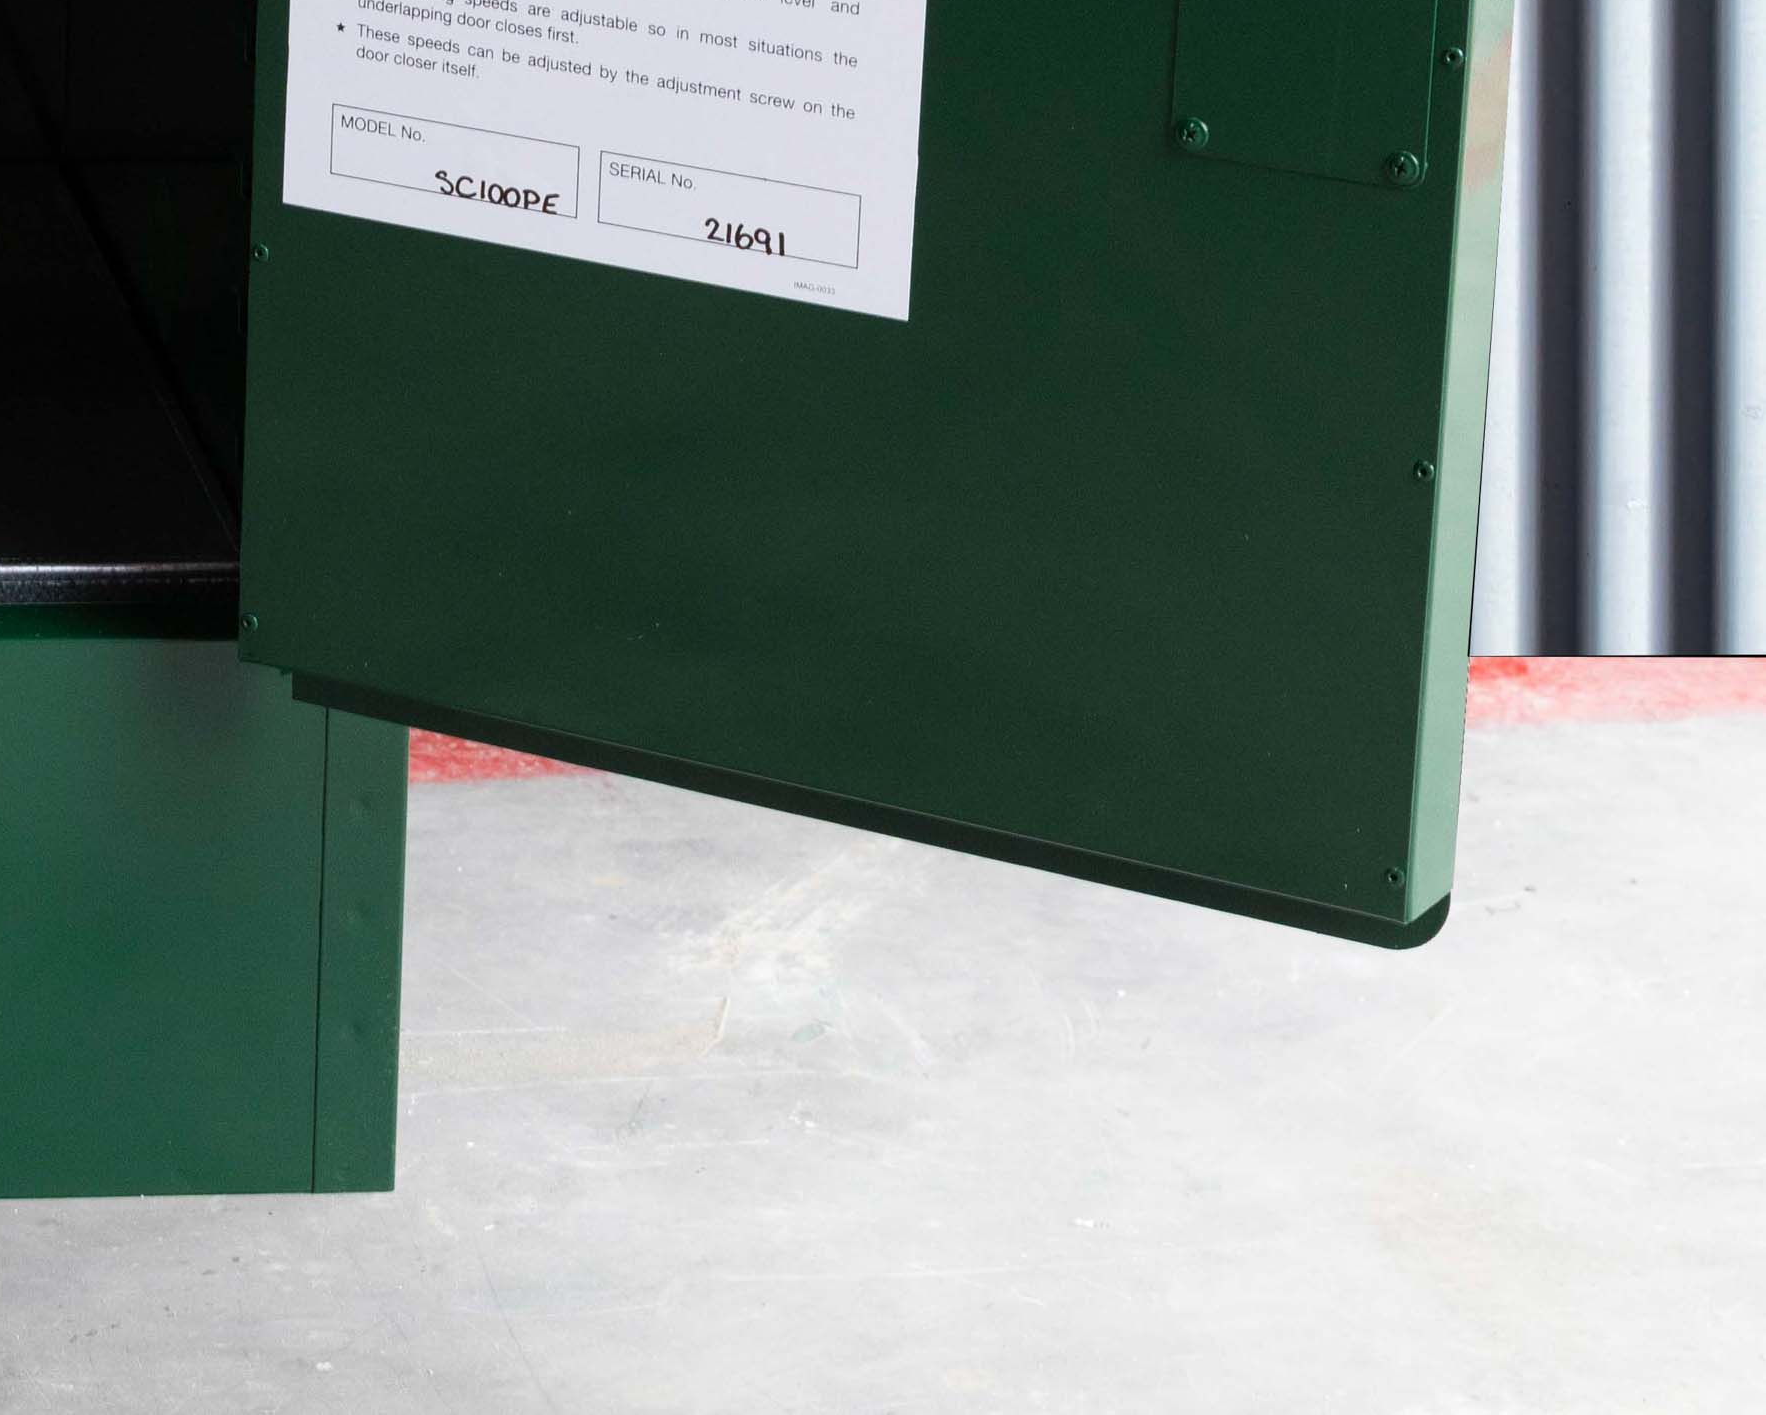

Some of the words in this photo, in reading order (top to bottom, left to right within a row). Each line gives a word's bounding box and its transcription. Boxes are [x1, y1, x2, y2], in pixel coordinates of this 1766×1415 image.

[356, 45, 390, 63] door
[393, 52, 438, 71] closer
[356, 23, 401, 44] These
[407, 34, 460, 54] speeds
[467, 45, 494, 60] can
[501, 48, 521, 64] be
[527, 54, 592, 76] adjusted
[599, 64, 618, 83] by
[625, 69, 649, 86] the
[656, 76, 741, 101] adjustment
[749, 92, 796, 110] screw
[802, 101, 823, 114] on
[831, 103, 856, 120] the
[340, 113, 397, 137] MODEL
[401, 124, 425, 143] No.
[608, 161, 666, 185] SERIAL
[671, 172, 696, 191] No.
[704, 217, 786, 256] 21691
